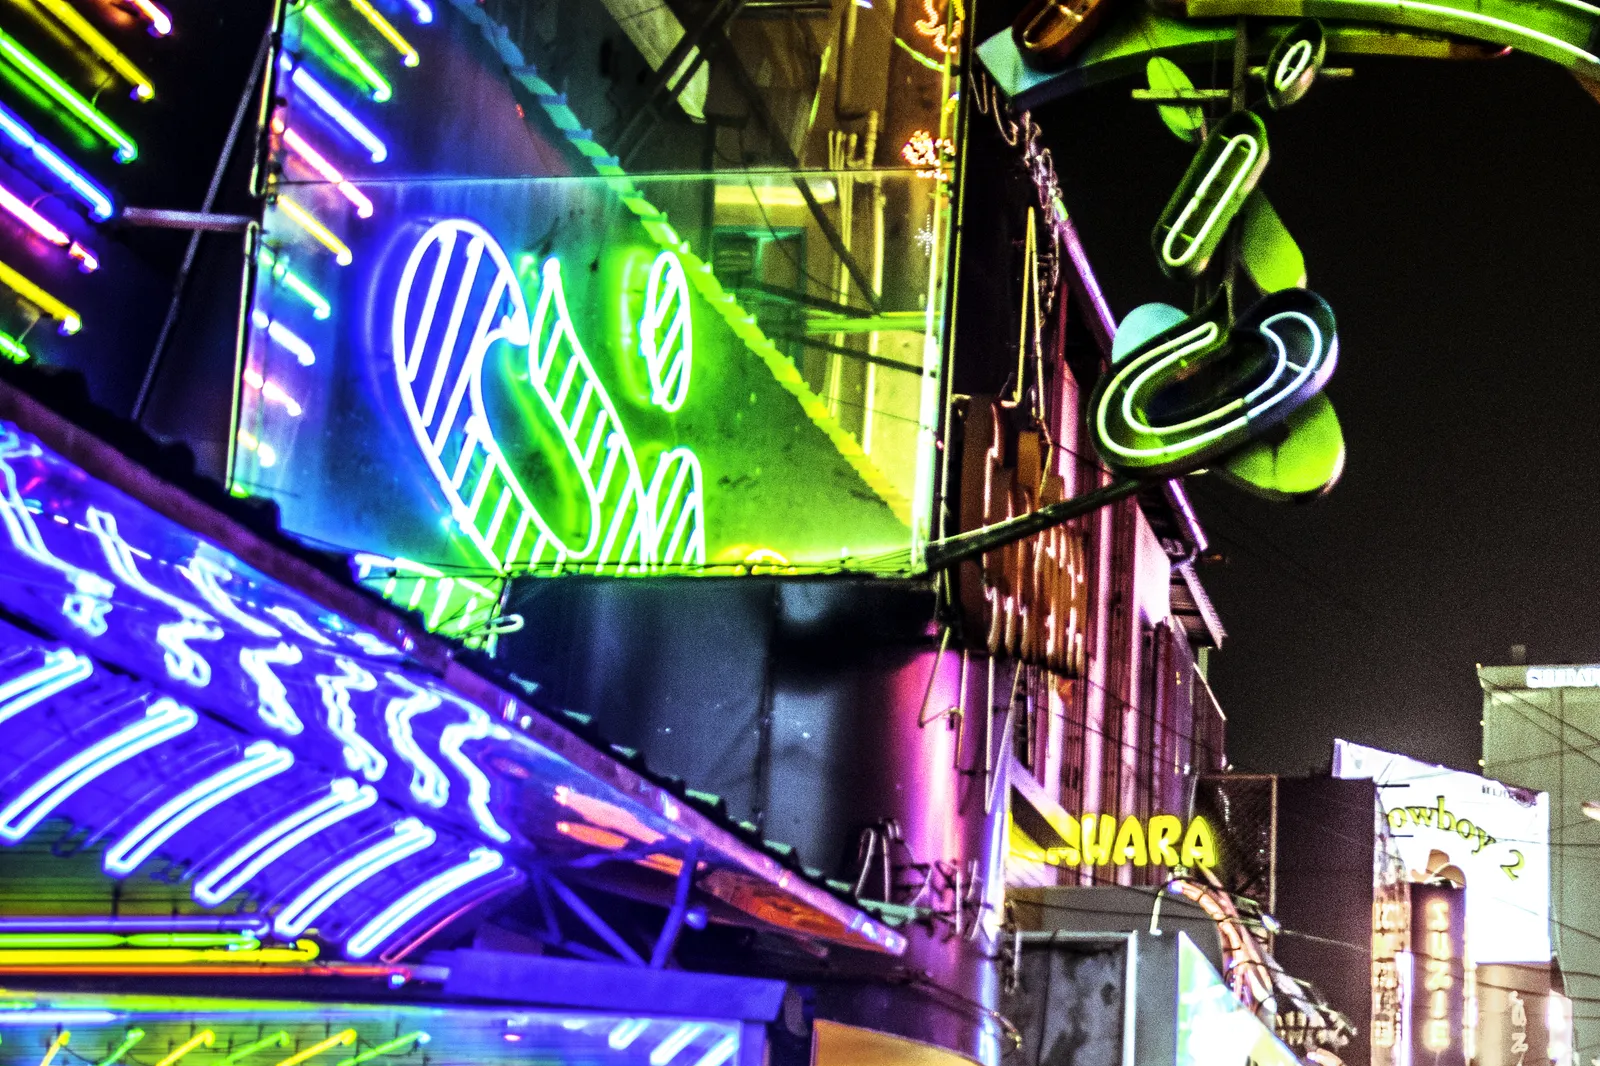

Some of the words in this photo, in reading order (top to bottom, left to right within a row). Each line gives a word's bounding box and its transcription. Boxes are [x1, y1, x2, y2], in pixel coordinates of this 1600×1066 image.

[1046, 813, 1217, 867] HARA
[1386, 795, 1497, 856] owboy
[1500, 849, 1525, 881] 2
